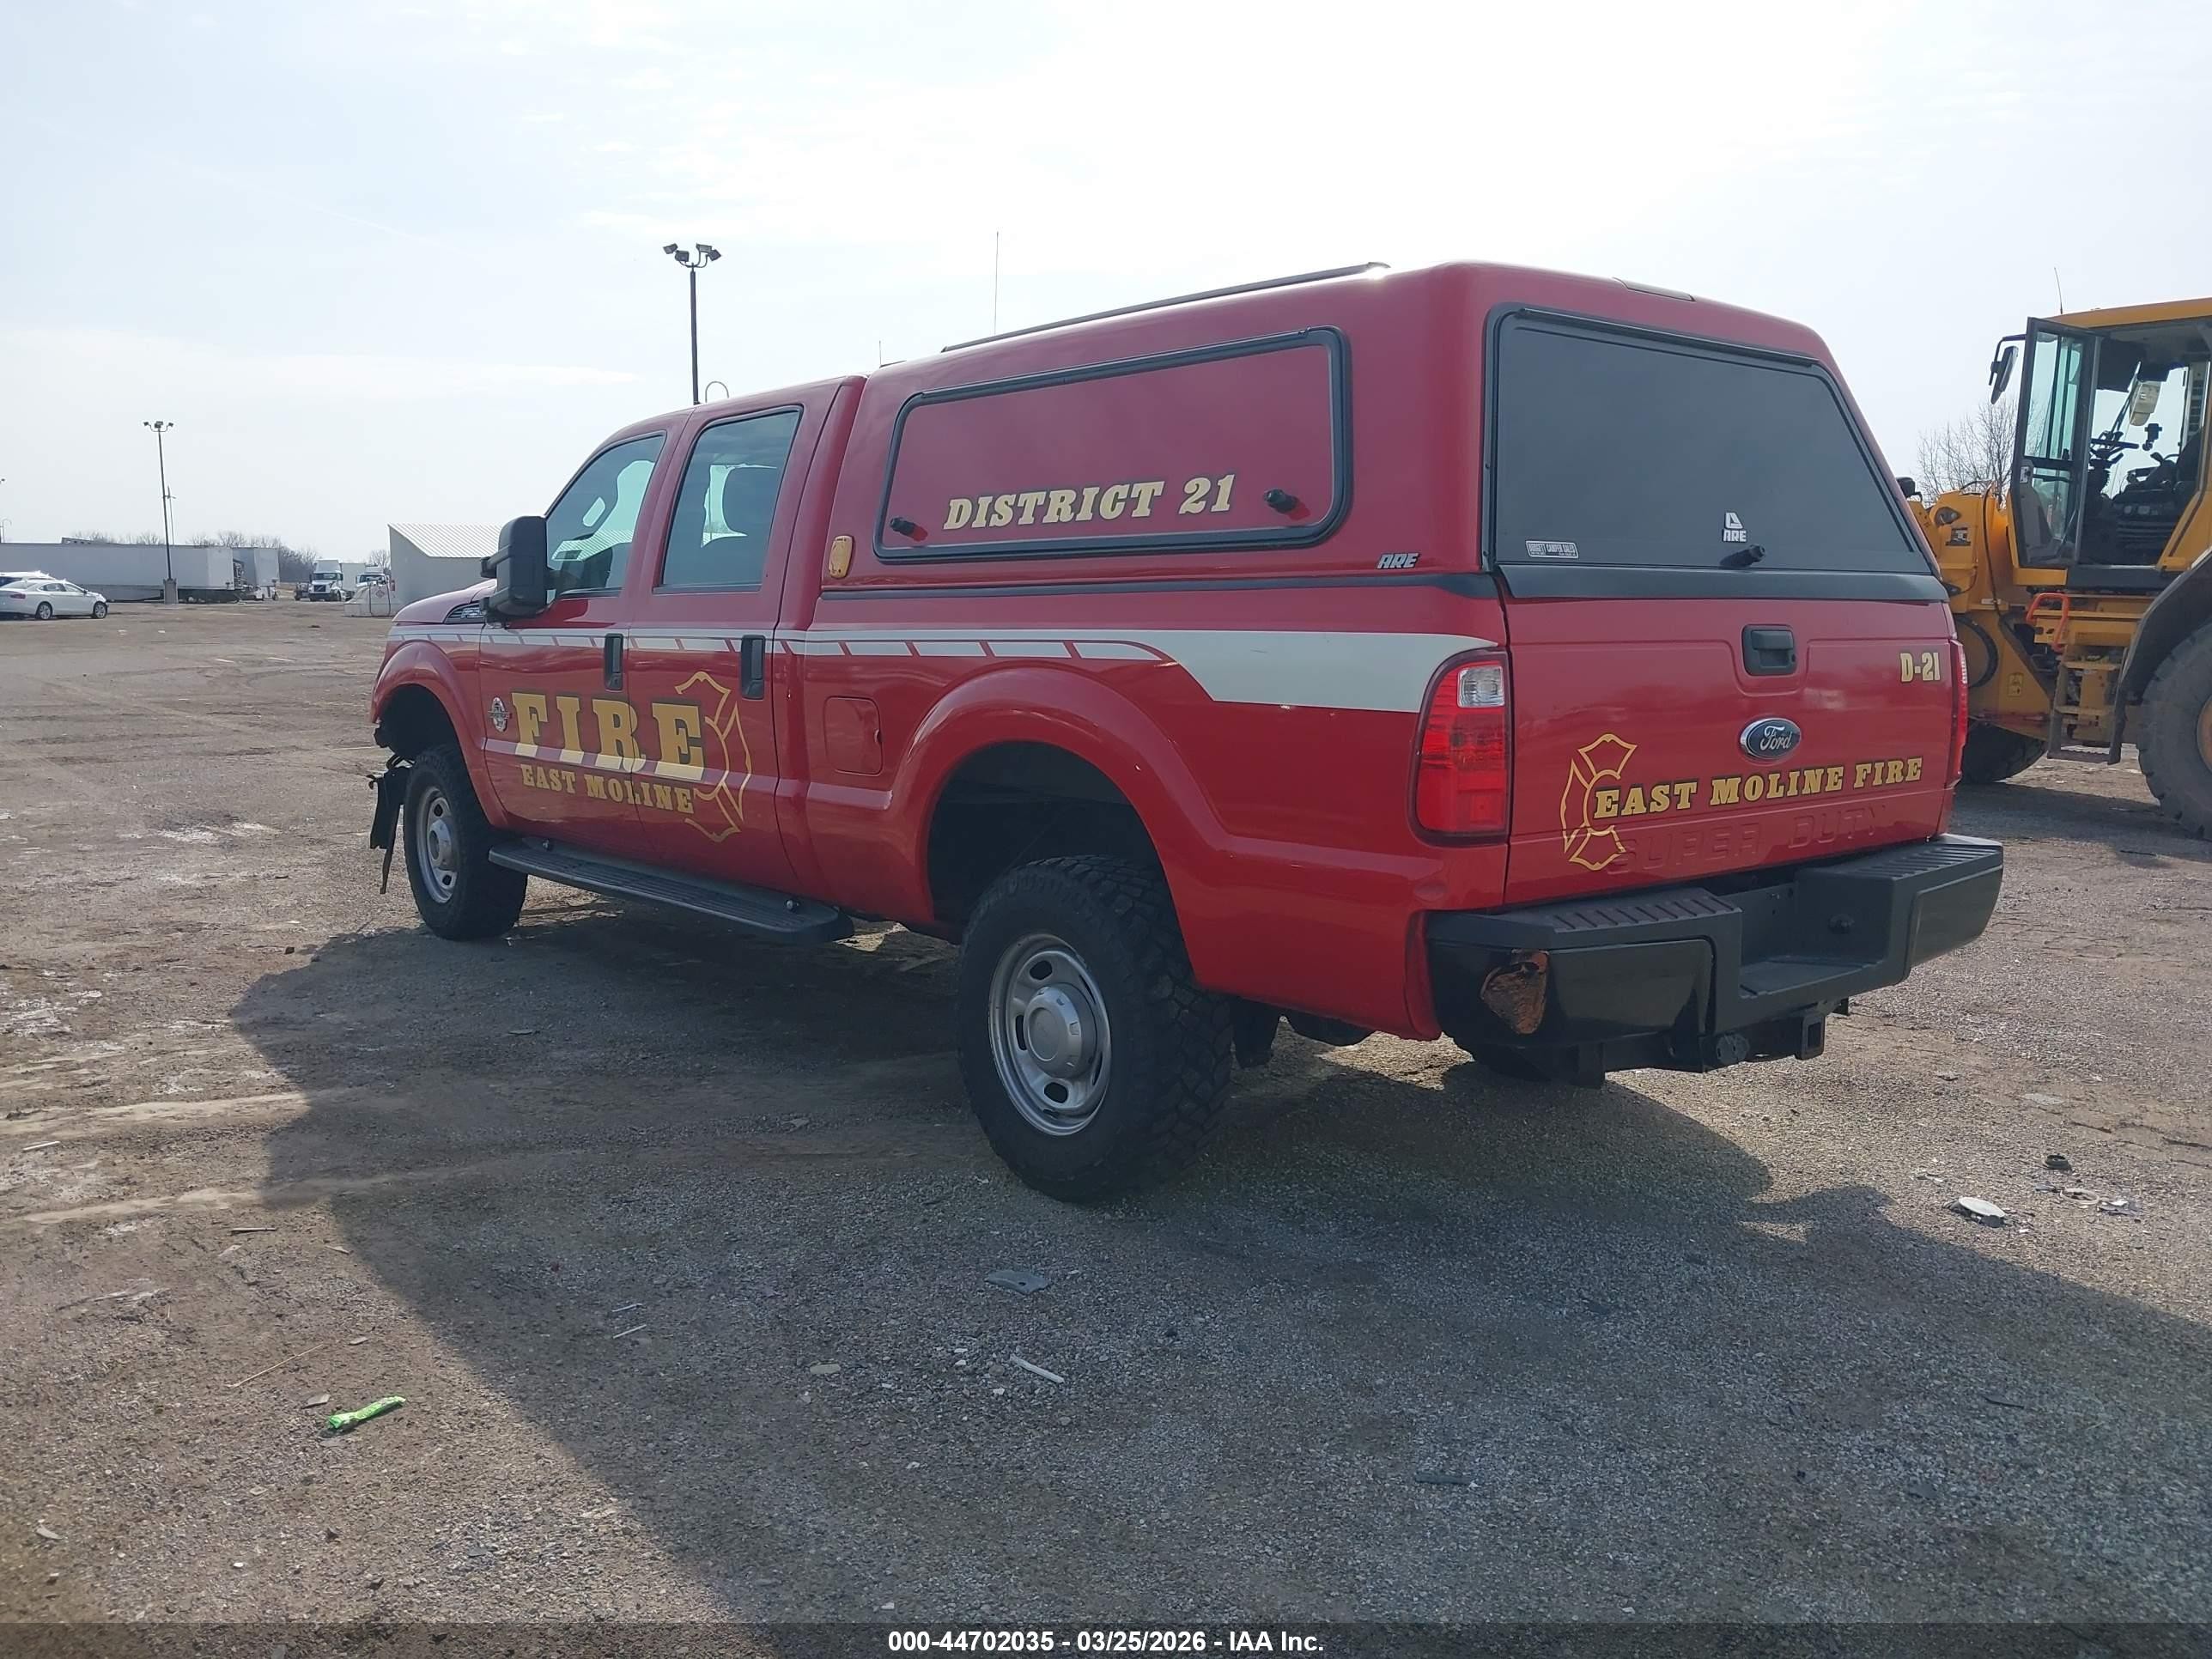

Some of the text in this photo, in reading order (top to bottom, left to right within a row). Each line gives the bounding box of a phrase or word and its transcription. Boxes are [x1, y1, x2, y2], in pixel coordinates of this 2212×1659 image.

[943, 473, 1236, 531] DISTRICT 21
[1376, 552, 1419, 569] ARE
[1899, 652, 1941, 683] D-21
[511, 692, 704, 781] FIRE
[1760, 726, 1793, 750] Ford
[520, 763, 695, 814] EAST MOLINE
[1594, 757, 1923, 818] EAST MOLINE FIRE
